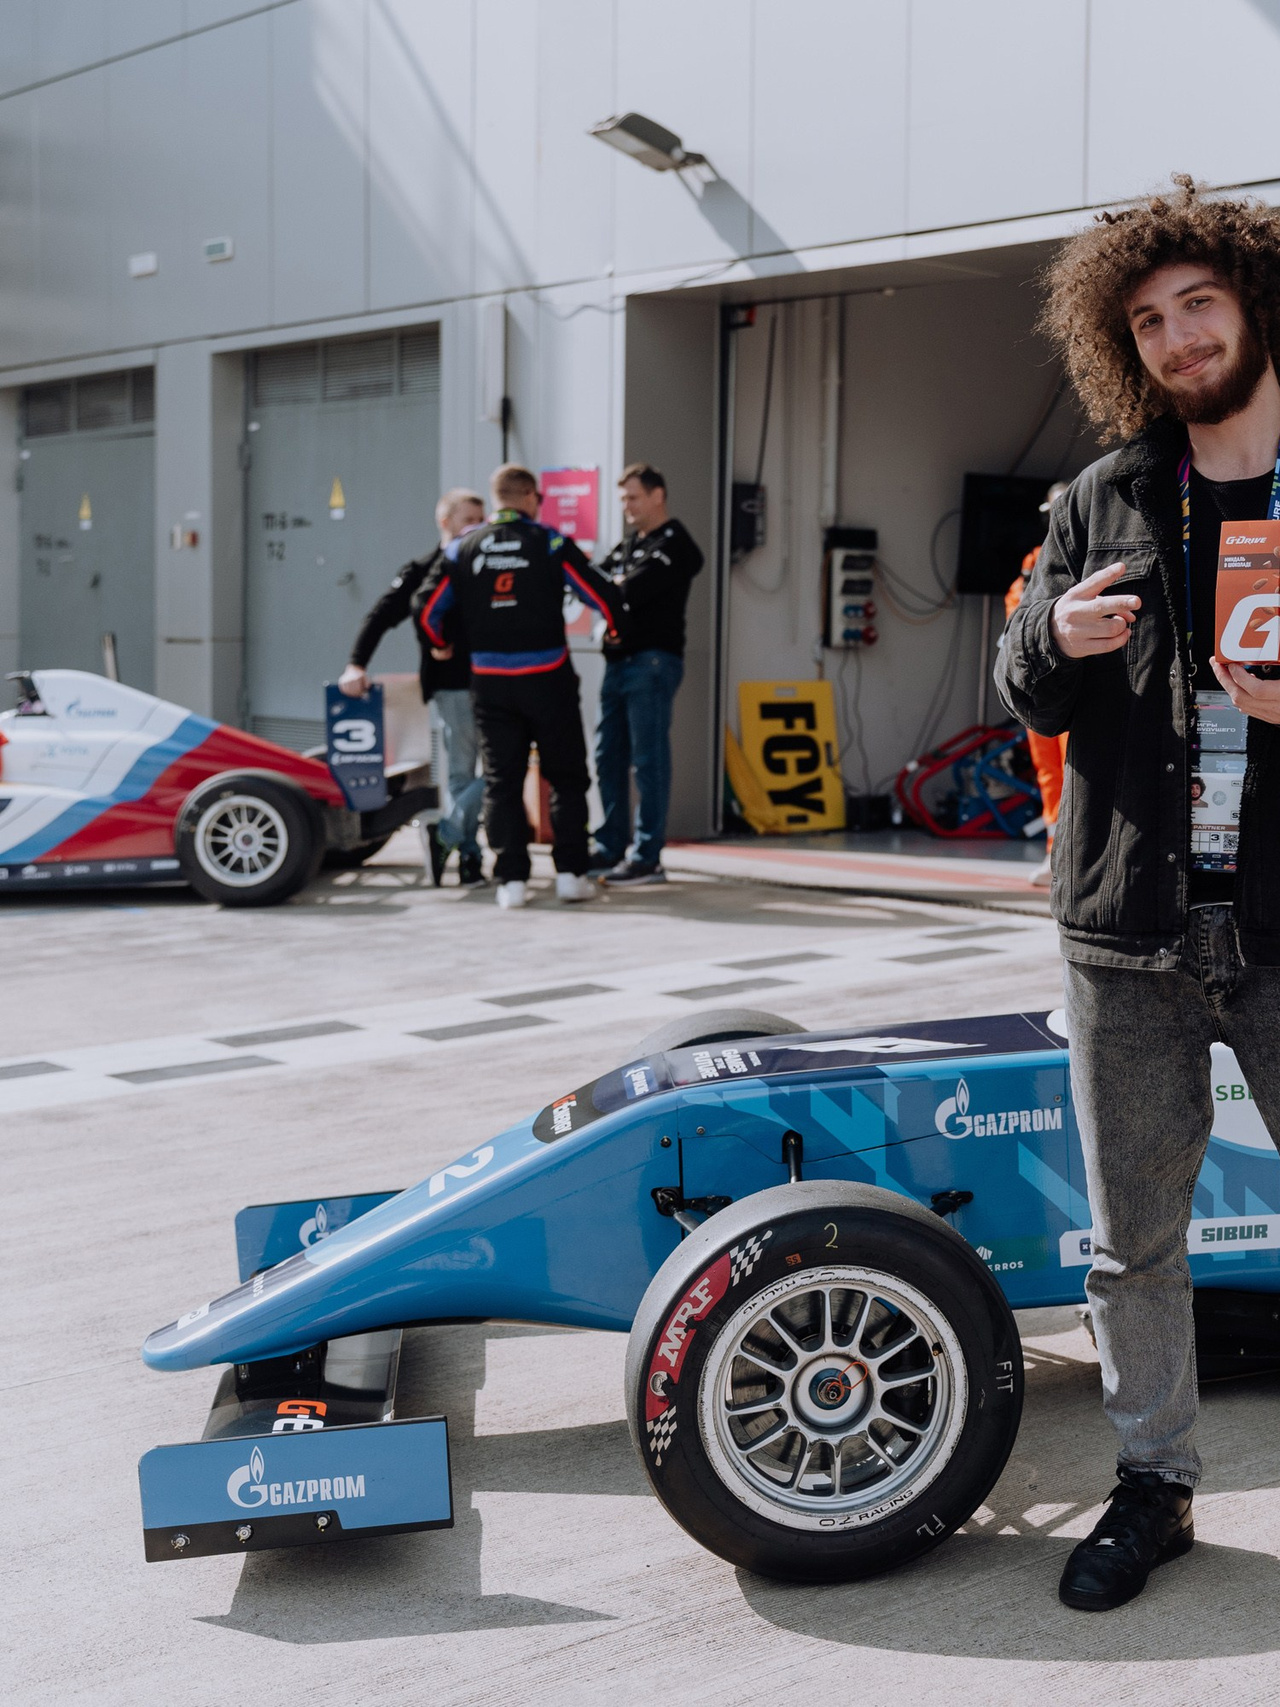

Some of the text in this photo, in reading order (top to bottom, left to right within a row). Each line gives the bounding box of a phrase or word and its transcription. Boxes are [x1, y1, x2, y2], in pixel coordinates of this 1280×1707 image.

[332, 718, 377, 753] 3
[1210, 833, 1220, 842] 3
[1215, 1084, 1254, 1102] SB
[974, 1107, 1063, 1138] GAZPROM
[429, 1145, 494, 1198] 2
[824, 1222, 839, 1249] 2
[1201, 1224, 1268, 1243] SIBUR
[658, 1277, 713, 1368] MRF
[269, 1474, 366, 1506] GAZPROM
[858, 1488, 915, 1522] RACING
